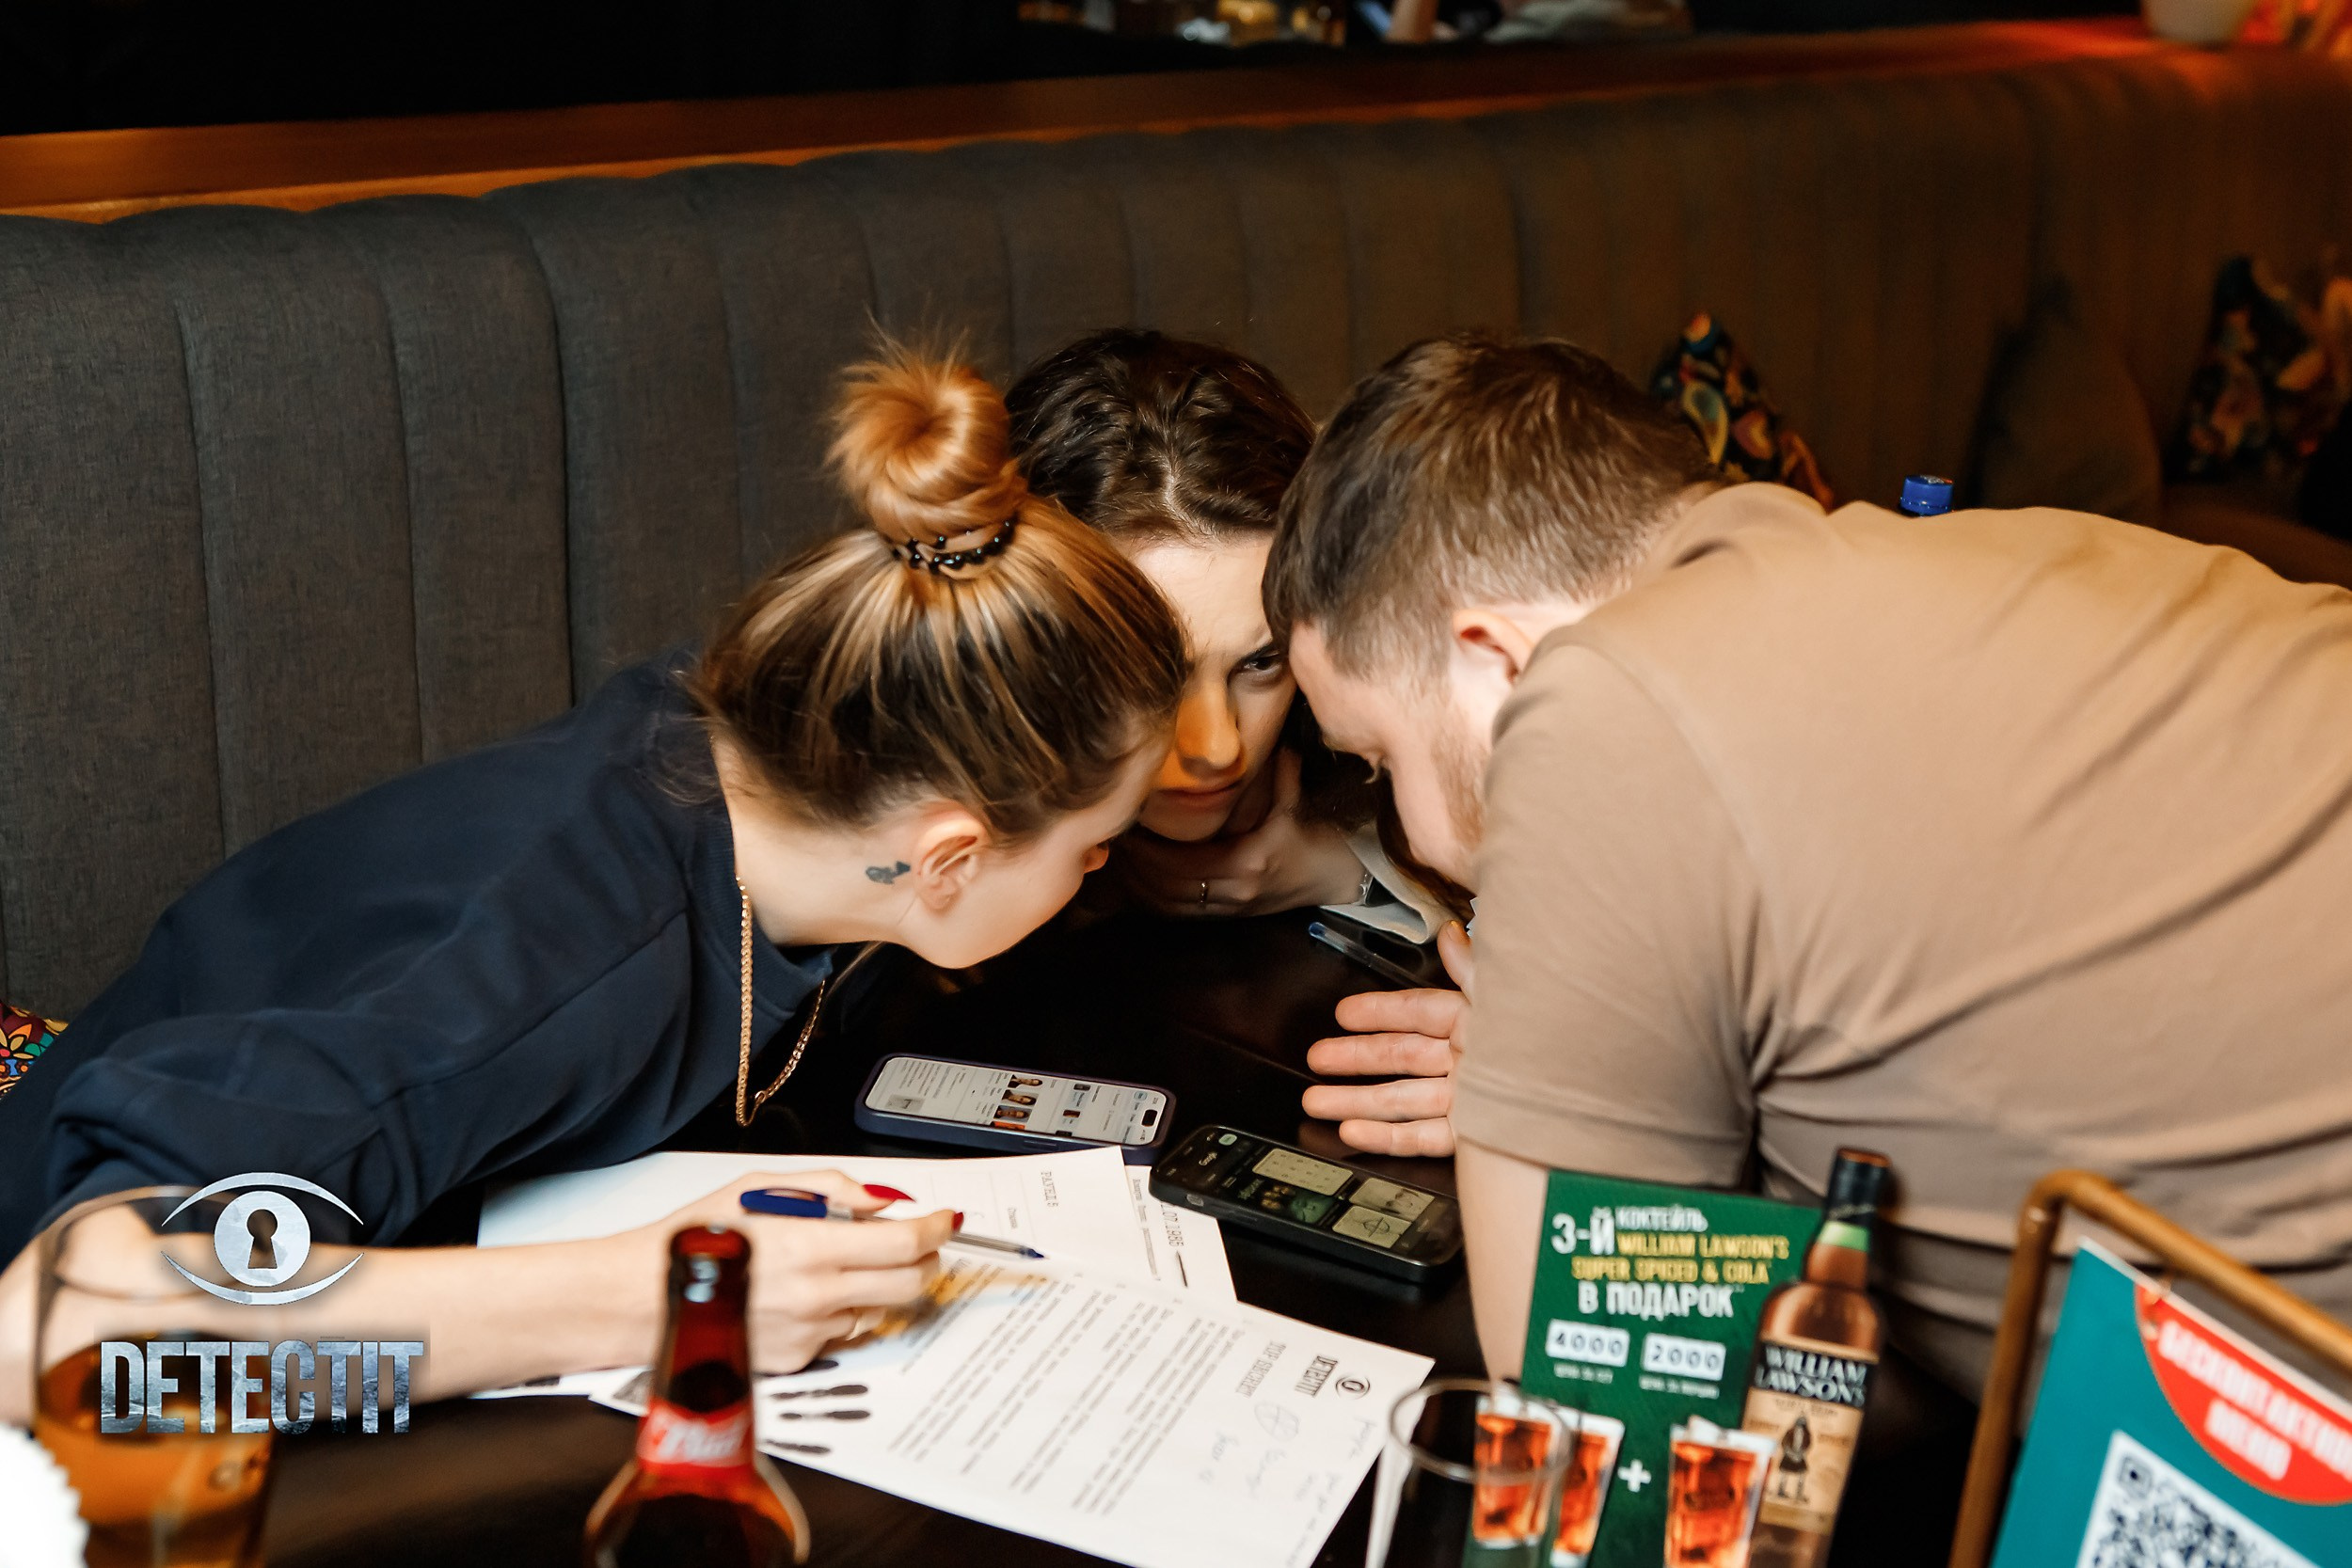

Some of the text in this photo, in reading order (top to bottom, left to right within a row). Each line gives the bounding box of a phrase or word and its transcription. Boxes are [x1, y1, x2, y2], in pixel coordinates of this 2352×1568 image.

[1160, 1203, 1184, 1248] 1.07.1985
[1614, 1204, 1708, 1233] КОКТЕЙЛЬ
[1616, 1232, 1789, 1259] WILLIAM LAWSON'S
[1571, 1256, 1630, 1281] SUPER
[1634, 1257, 1698, 1282] SPICED
[1702, 1259, 1720, 1283] &
[1578, 1280, 1598, 1314] В
[1765, 1344, 1867, 1388] WILLIAM
